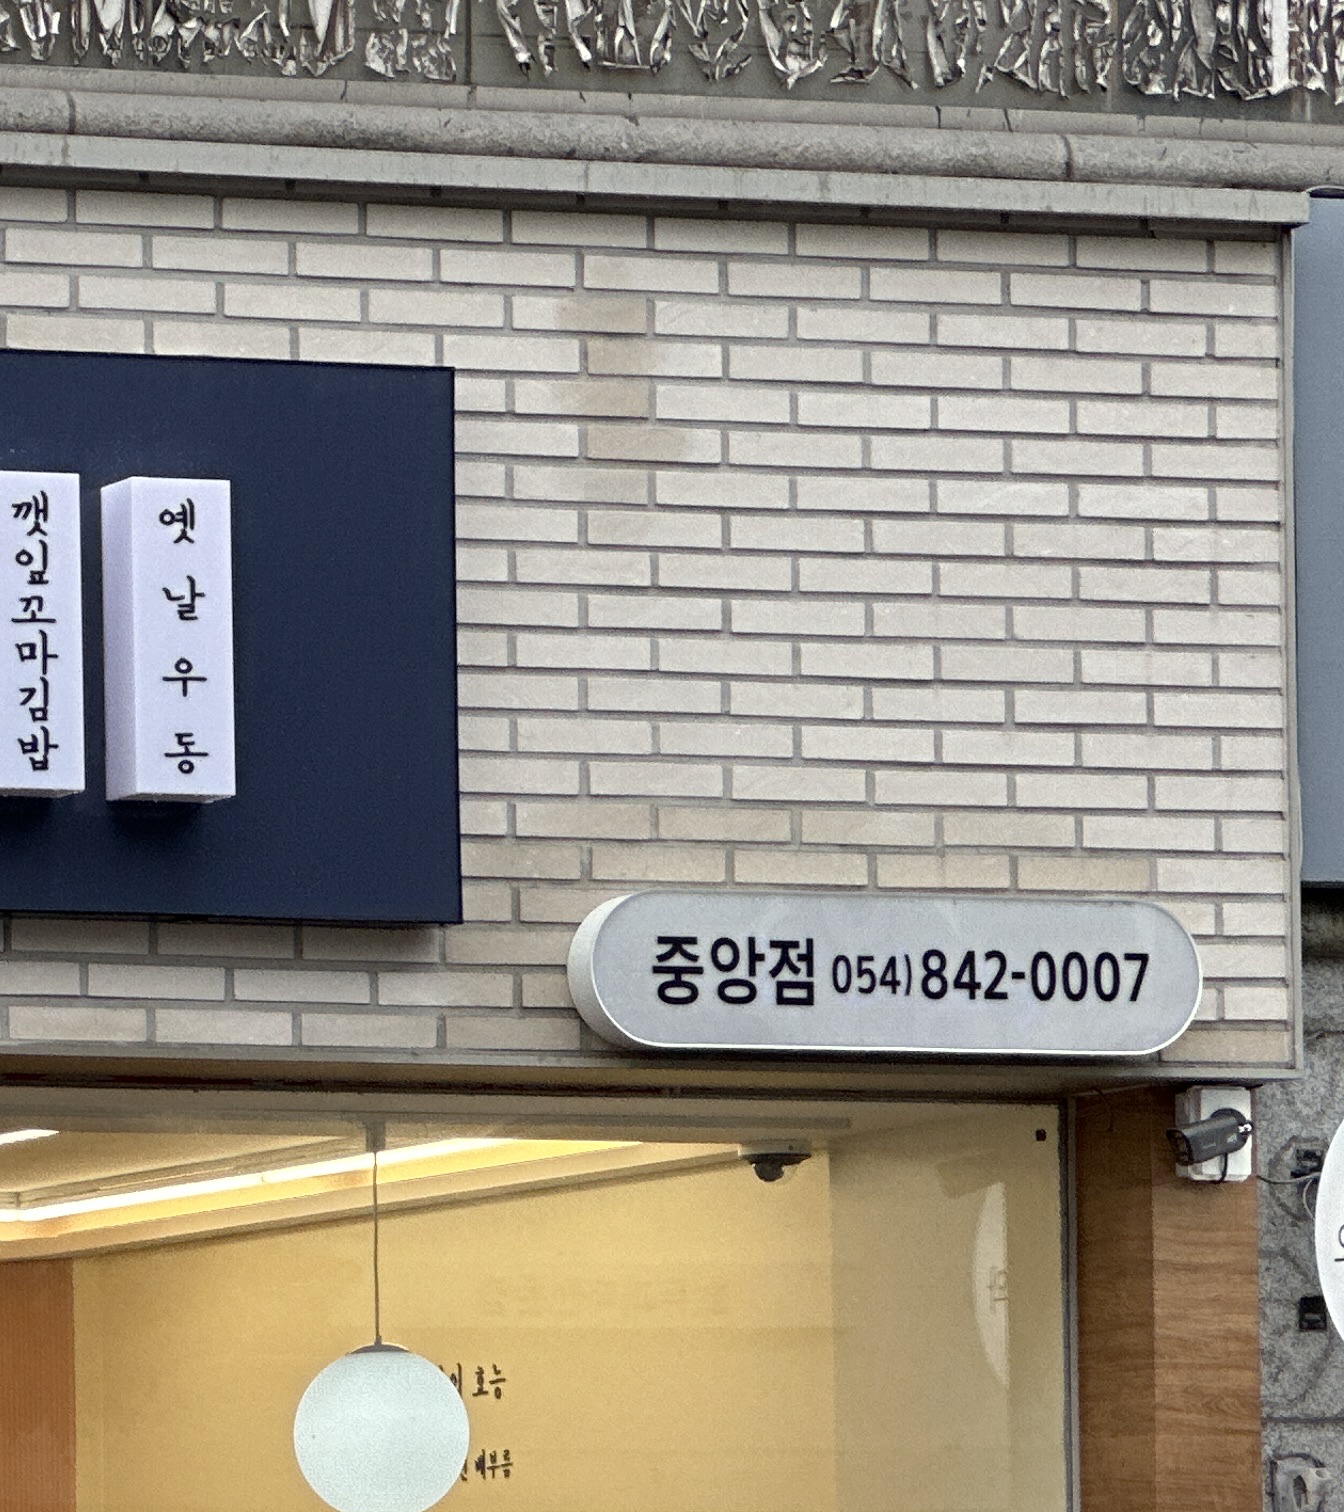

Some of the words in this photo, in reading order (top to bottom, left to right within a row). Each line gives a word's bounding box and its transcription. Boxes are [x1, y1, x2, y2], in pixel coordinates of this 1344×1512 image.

[11, 490, 59, 772] 깻잎꼬마김밥
[159, 498, 209, 775] 옛날우동
[651, 935, 816, 1006] 중앙점
